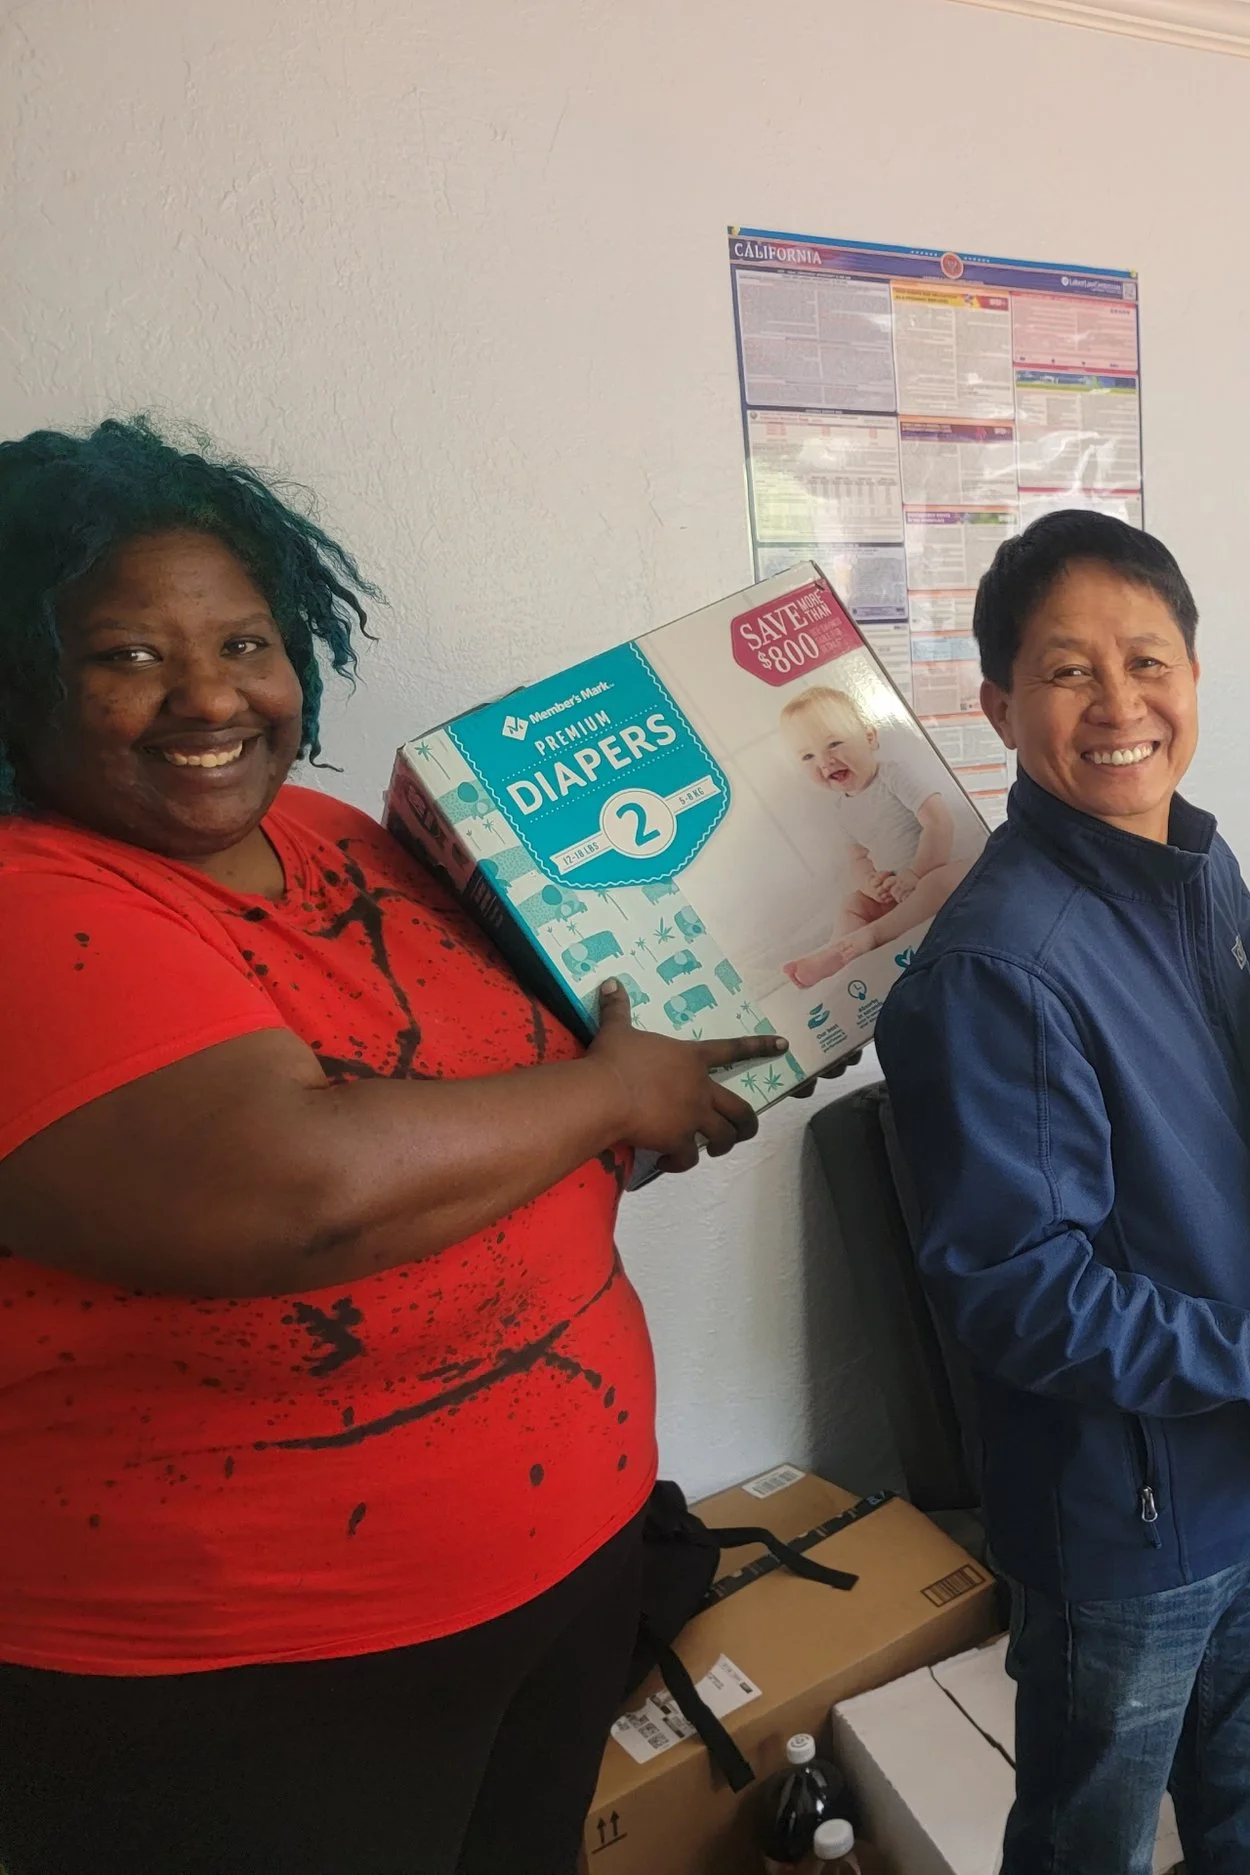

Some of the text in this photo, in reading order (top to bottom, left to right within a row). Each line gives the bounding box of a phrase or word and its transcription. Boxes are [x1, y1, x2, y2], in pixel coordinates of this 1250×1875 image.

[734, 242, 823, 265] CALIFORNIA
[740, 602, 809, 651] SAVE
[796, 590, 824, 611] MORE
[805, 602, 832, 623] THAN
[758, 632, 819, 673] $800
[528, 681, 612, 725] Member's Mark
[534, 710, 611, 756] PREMIUM
[506, 713, 677, 816] DIAPERS
[692, 786, 705, 799] KG
[616, 802, 661, 847] 2
[584, 842, 600, 858] LBS
